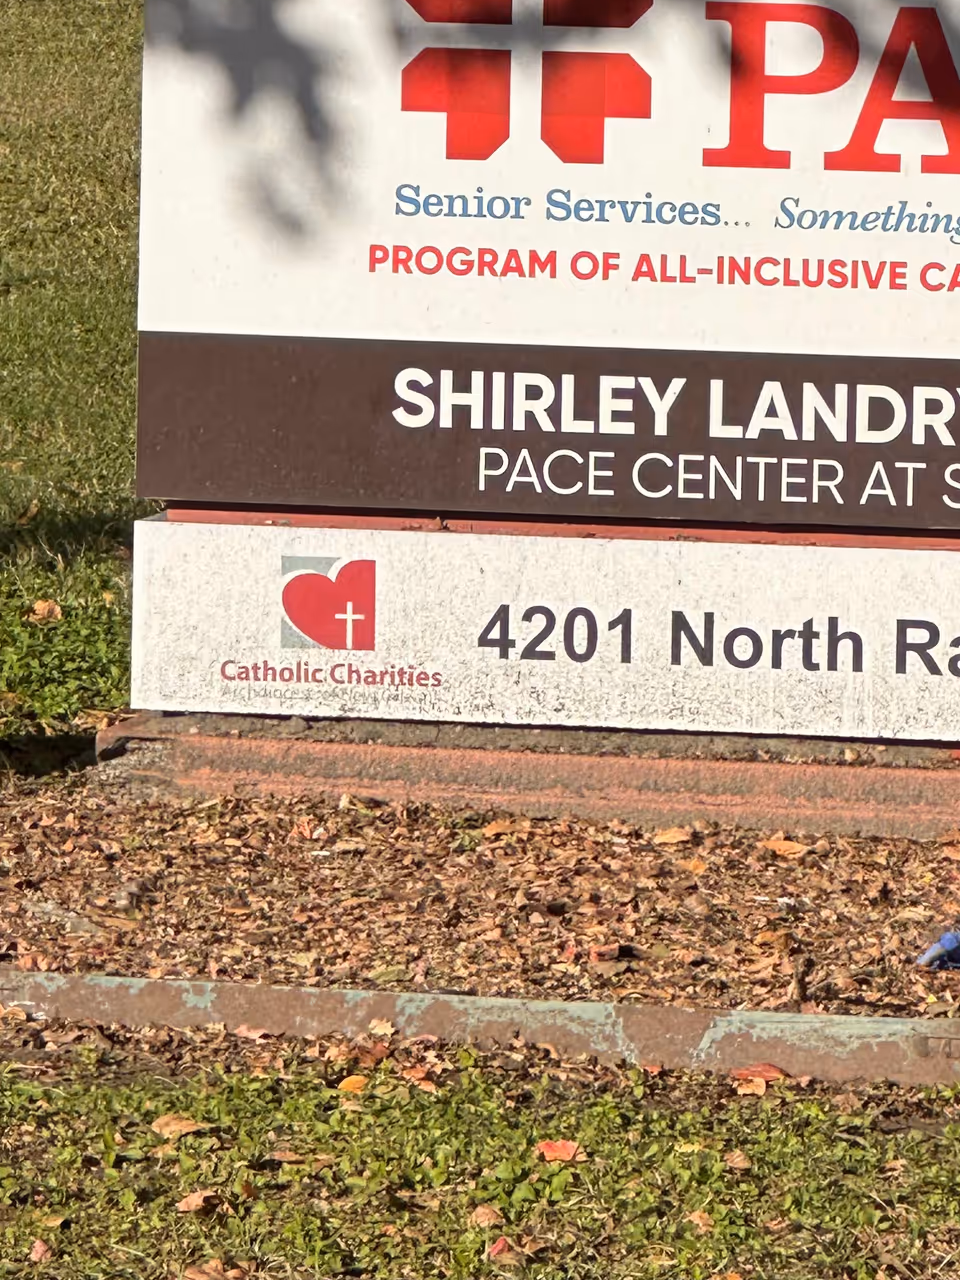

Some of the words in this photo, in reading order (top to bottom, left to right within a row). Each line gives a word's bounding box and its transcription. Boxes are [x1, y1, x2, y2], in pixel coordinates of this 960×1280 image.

[394, 183, 532, 221] Senior
[368, 244, 557, 280] PROGRAM
[570, 251, 621, 282] OF
[631, 254, 908, 292] ALL-INCLUSIVE
[391, 367, 687, 438] SHIRLEY
[478, 447, 616, 497] PACE
[631, 452, 845, 505] CENTER
[859, 460, 927, 507] AT
[477, 603, 634, 664] 4201
[669, 610, 864, 673] North
[220, 659, 324, 684] Catholic
[329, 663, 443, 688] Charities
